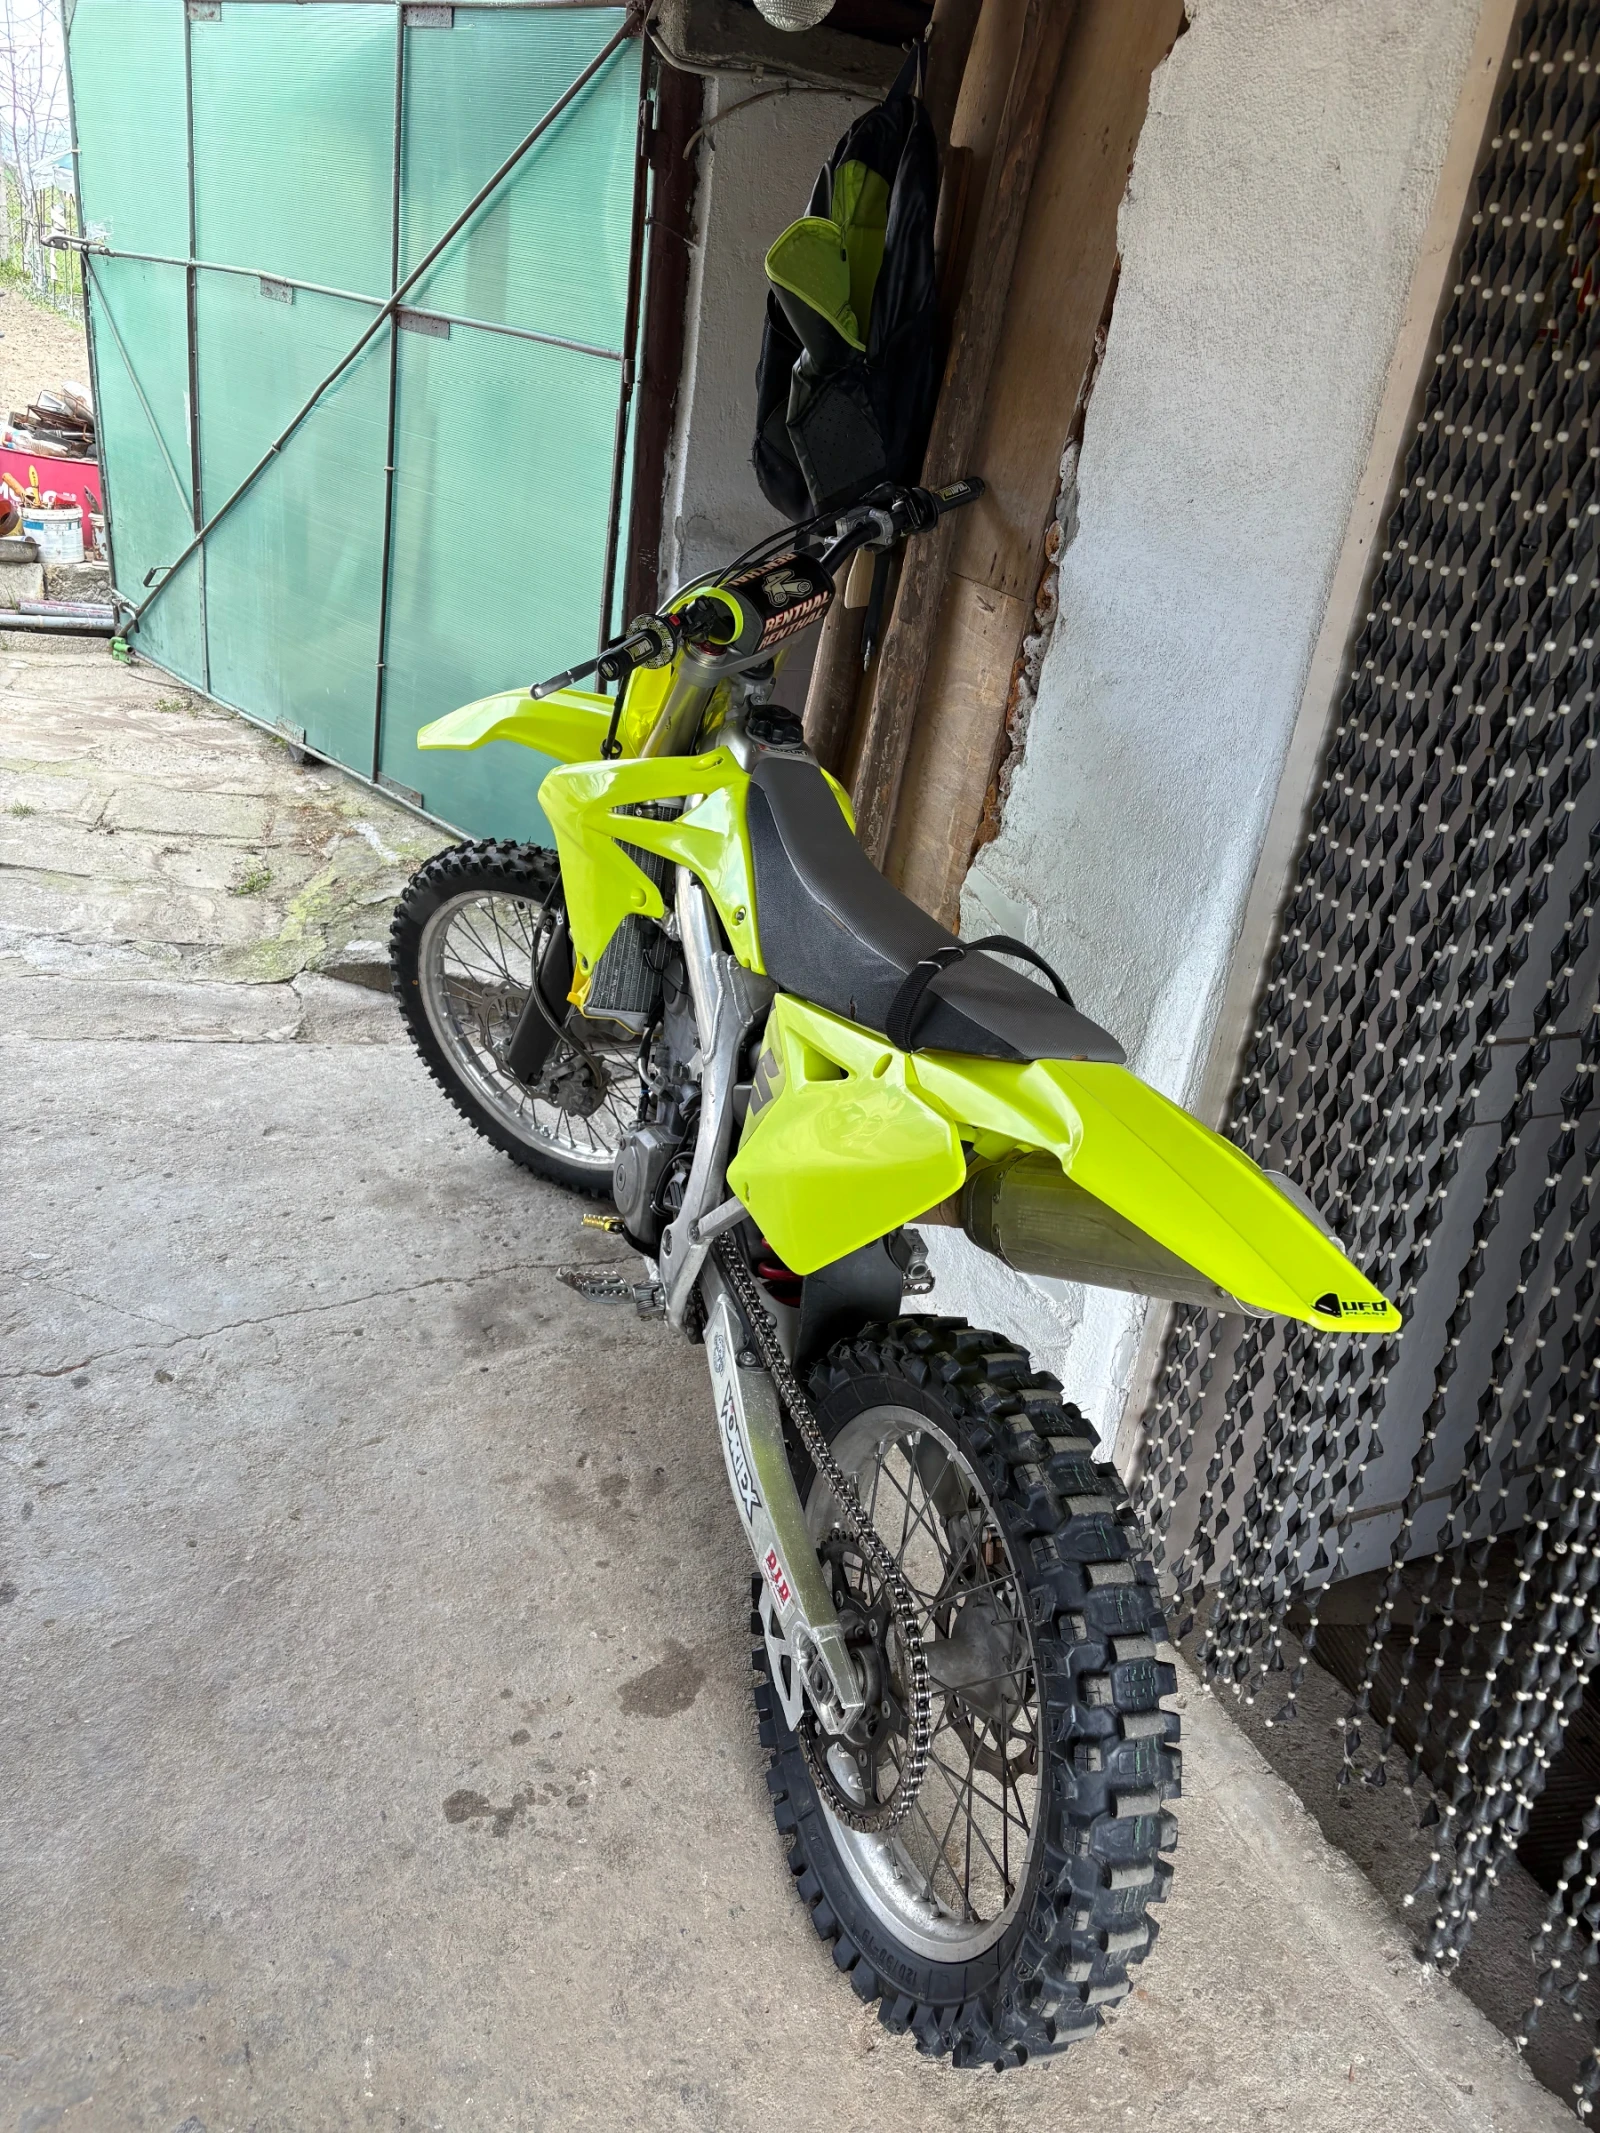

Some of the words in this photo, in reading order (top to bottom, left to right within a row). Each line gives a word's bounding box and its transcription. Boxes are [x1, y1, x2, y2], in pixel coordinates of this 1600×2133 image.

[757, 607, 824, 651] RENTHAL
[764, 590, 829, 634] RENTHAL
[1342, 1300, 1387, 1312] UFO
